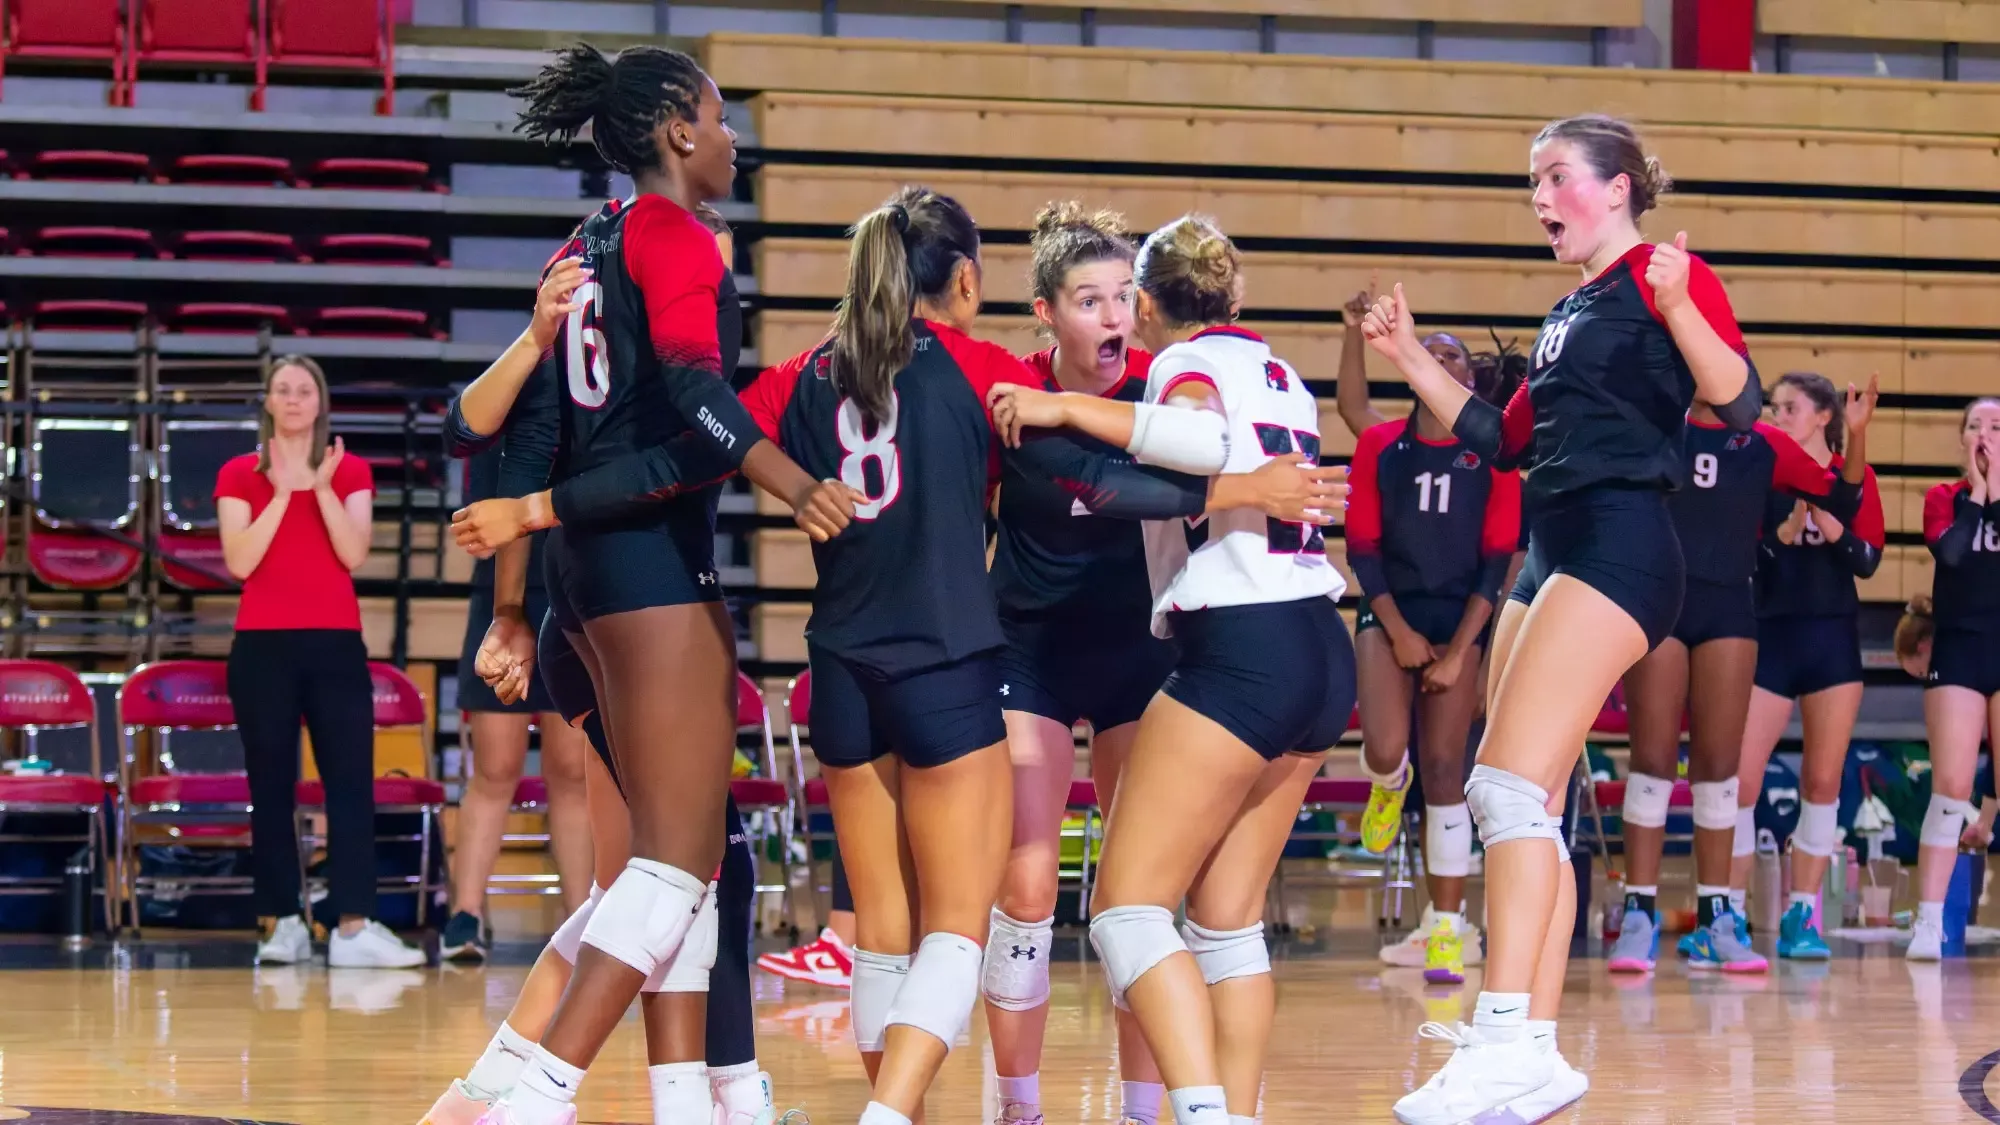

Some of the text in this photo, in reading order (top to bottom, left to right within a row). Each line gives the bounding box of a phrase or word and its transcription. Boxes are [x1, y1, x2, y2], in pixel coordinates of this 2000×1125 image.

[567, 280, 611, 411] 6
[696, 405, 737, 450] LIONS
[837, 388, 903, 523] 8
[1693, 452, 1718, 489] 9
[1414, 471, 1451, 514] 11
